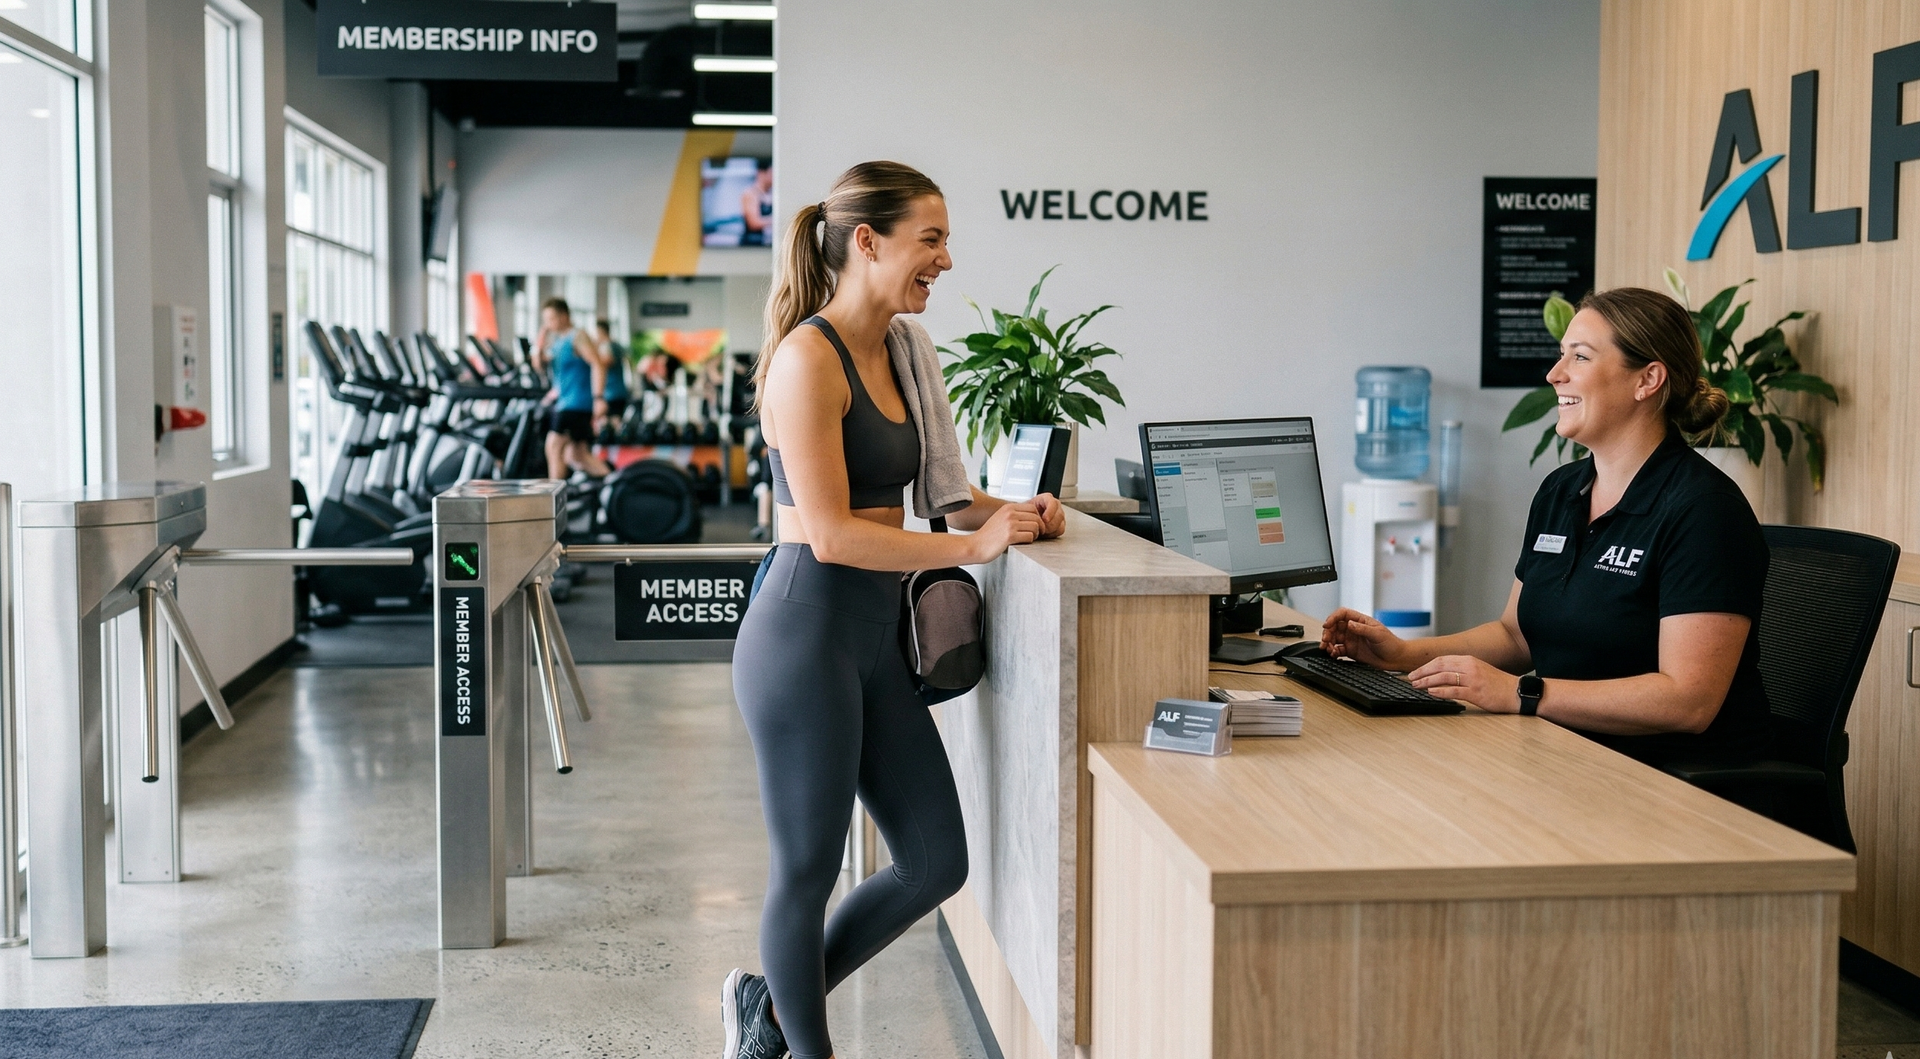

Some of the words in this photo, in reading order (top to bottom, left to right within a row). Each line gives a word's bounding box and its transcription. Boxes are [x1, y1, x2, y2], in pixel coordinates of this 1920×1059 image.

[338, 26, 524, 51] MEMBERSHIP
[531, 29, 598, 53] INFO
[1000, 189, 1209, 221] WELCOME
[1496, 192, 1591, 211] WELCOME
[1598, 545, 1644, 568] ALF
[640, 579, 745, 599] MEMBER
[646, 603, 739, 623] ACCESS
[456, 596, 470, 664] MEMBER
[457, 667, 471, 725] ACCESS
[1157, 710, 1181, 723] ALF
